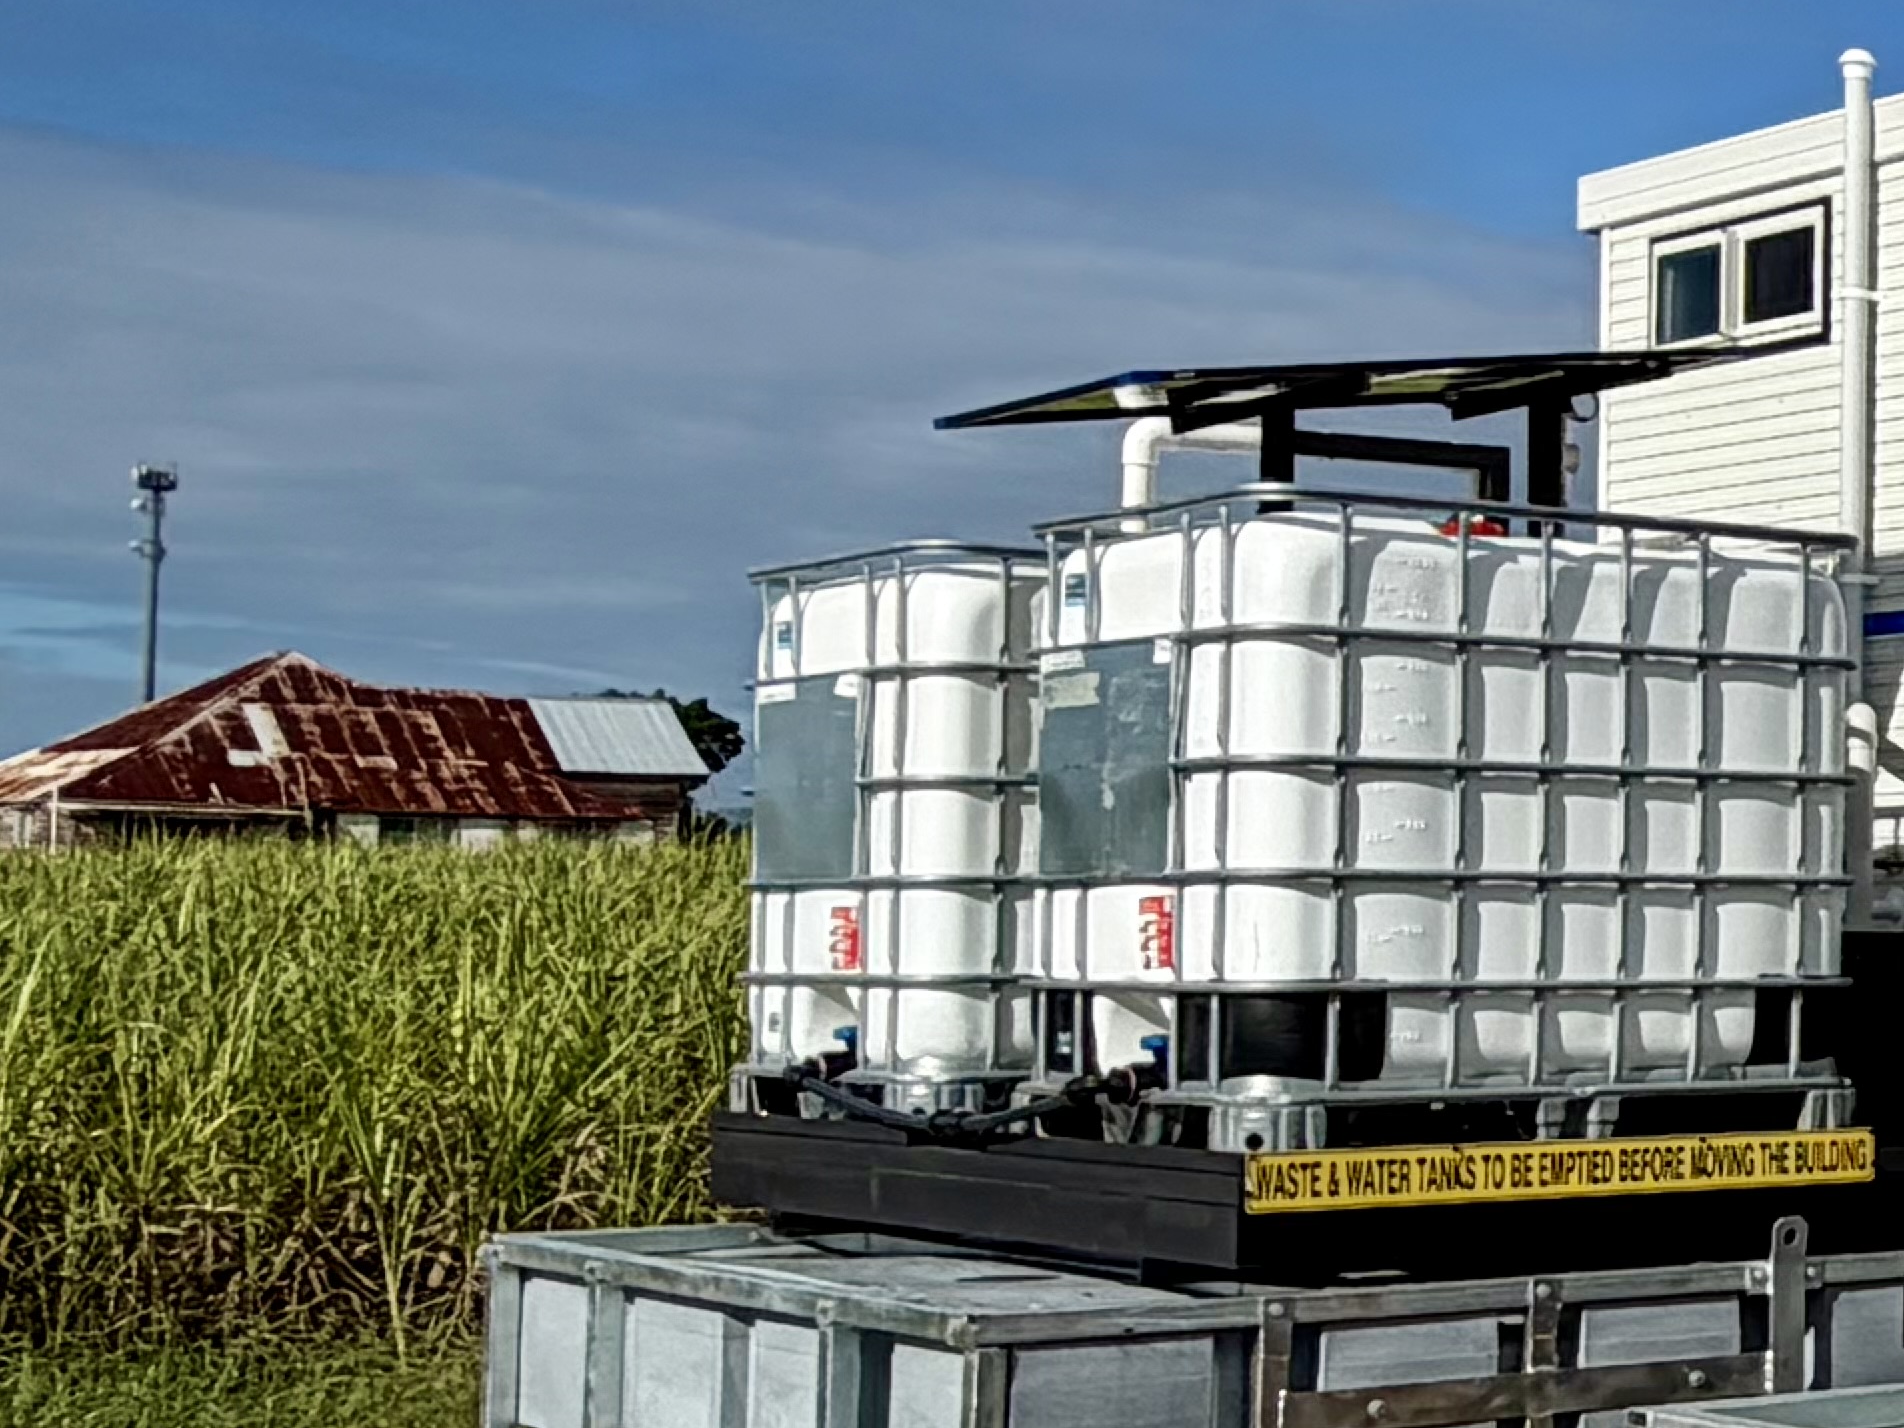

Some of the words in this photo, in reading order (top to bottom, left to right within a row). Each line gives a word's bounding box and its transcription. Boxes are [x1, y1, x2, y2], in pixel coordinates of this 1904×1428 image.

[1256, 1161, 1322, 1200] WASTE
[1328, 1161, 1340, 1197] &
[1346, 1158, 1411, 1197] WATER
[1416, 1154, 1476, 1192] TANKS
[1481, 1152, 1504, 1190] TO
[1511, 1152, 1533, 1188] BE
[1539, 1149, 1614, 1186] EMPTIED
[1619, 1145, 1686, 1182] BEFORE
[1690, 1142, 1754, 1179] MOVING
[1759, 1140, 1790, 1176] THE
[1795, 1138, 1867, 1174] BUILDING
